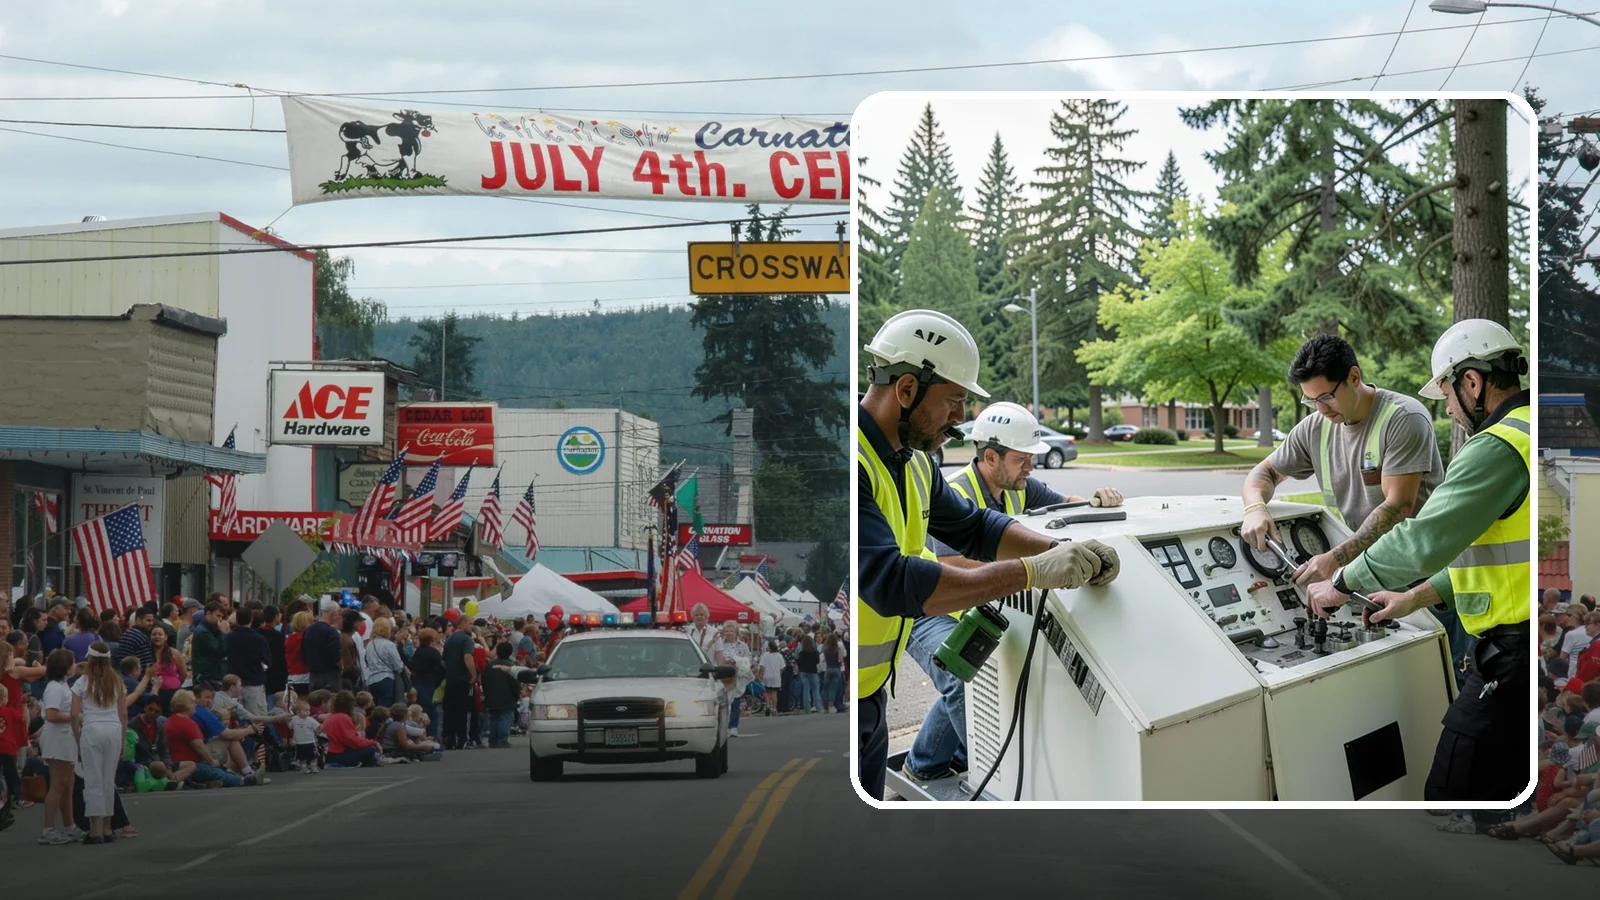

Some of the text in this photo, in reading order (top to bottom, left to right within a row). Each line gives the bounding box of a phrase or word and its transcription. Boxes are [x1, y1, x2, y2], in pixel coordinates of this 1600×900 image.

[481, 141, 605, 192] JULY
[632, 150, 746, 198] 4th.
[697, 254, 850, 280] CROSSWA
[283, 380, 373, 420] ACE
[405, 409, 485, 422] CEDAR LOG
[283, 421, 370, 436] Hardware
[416, 428, 477, 447] Coca-Cola
[83, 485, 155, 495] St. Vincent de Paul
[688, 526, 741, 535] CRNATION
[699, 535, 730, 543] GLASS
